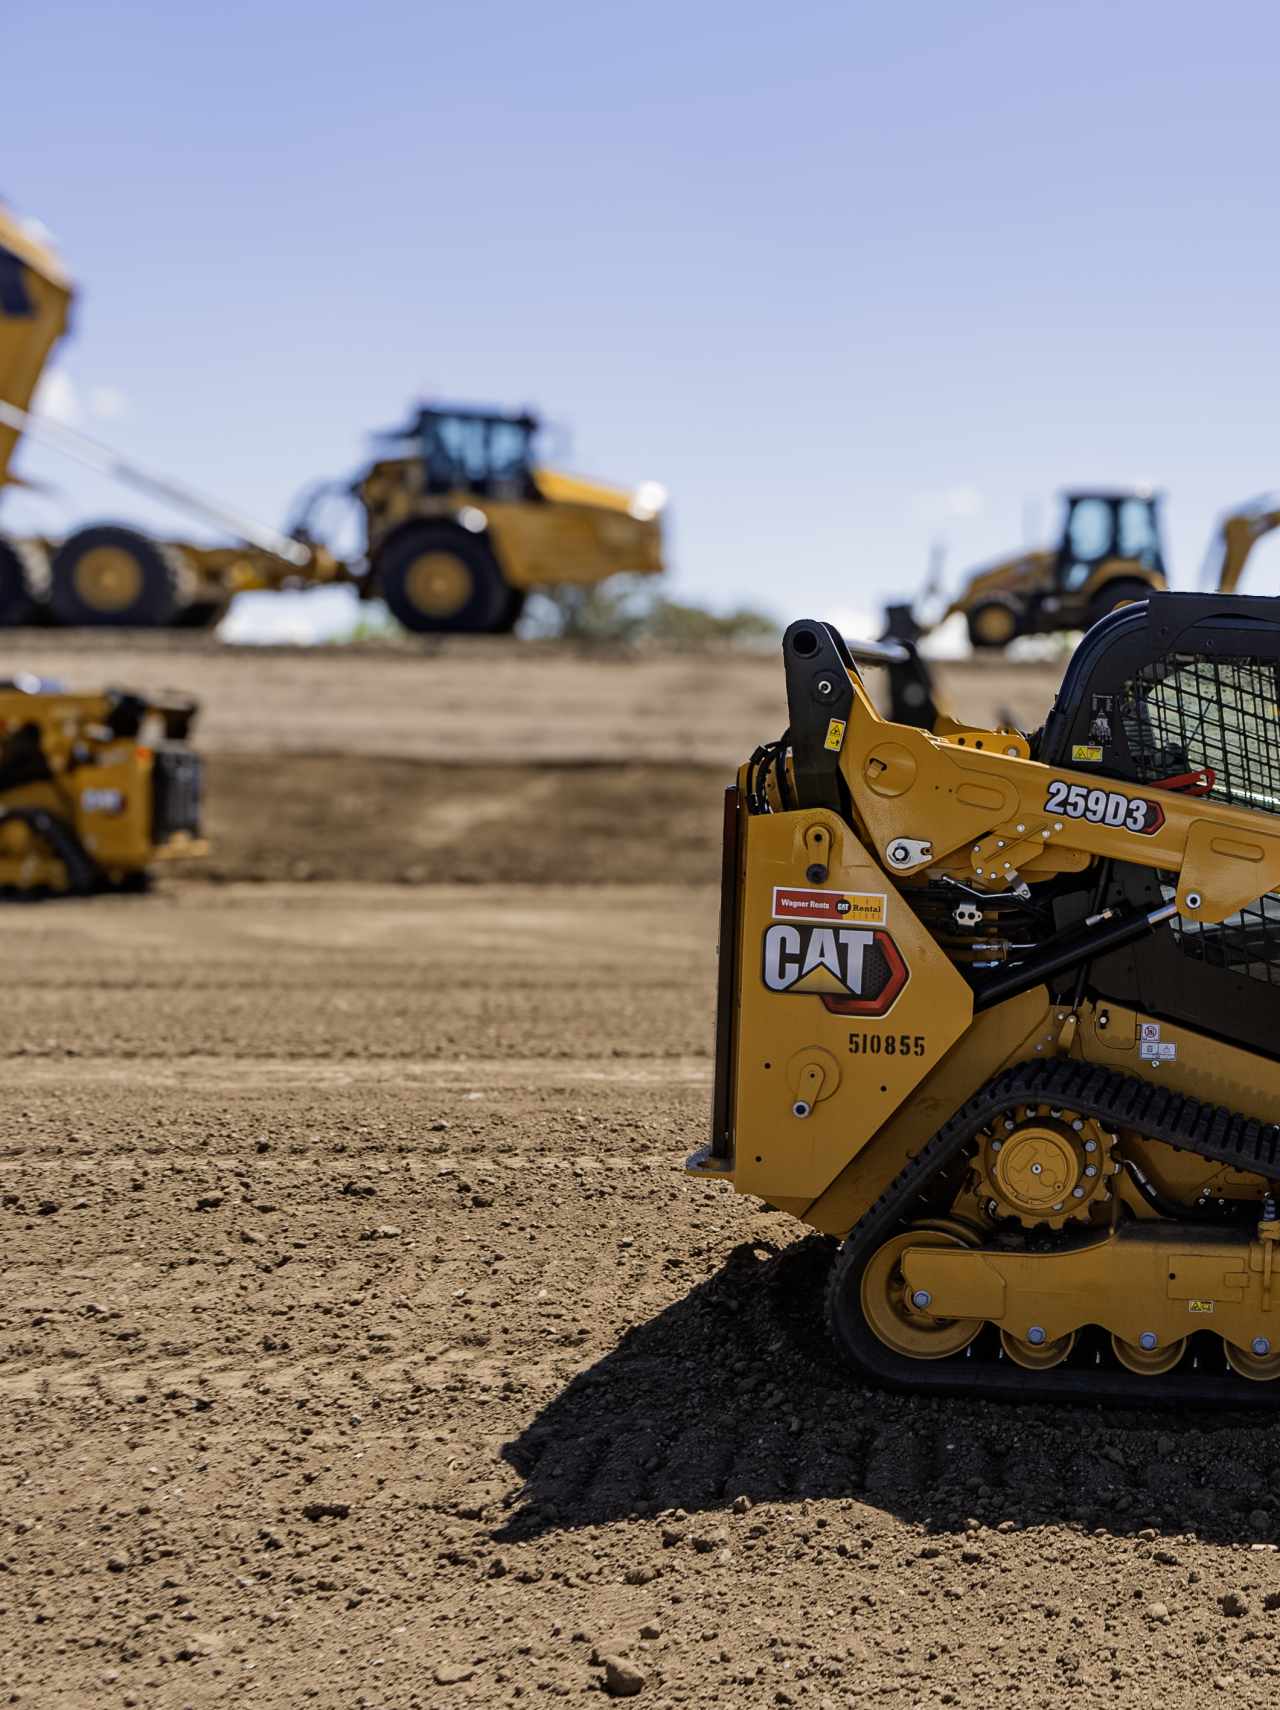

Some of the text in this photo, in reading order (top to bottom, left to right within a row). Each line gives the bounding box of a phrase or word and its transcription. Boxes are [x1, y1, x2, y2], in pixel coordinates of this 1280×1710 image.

[1045, 781, 1148, 831] 259D3
[781, 898, 830, 910] Wagner Rents
[837, 903, 881, 913] CAT Rental
[765, 925, 874, 995] CAT
[848, 1033, 925, 1057] 510855
